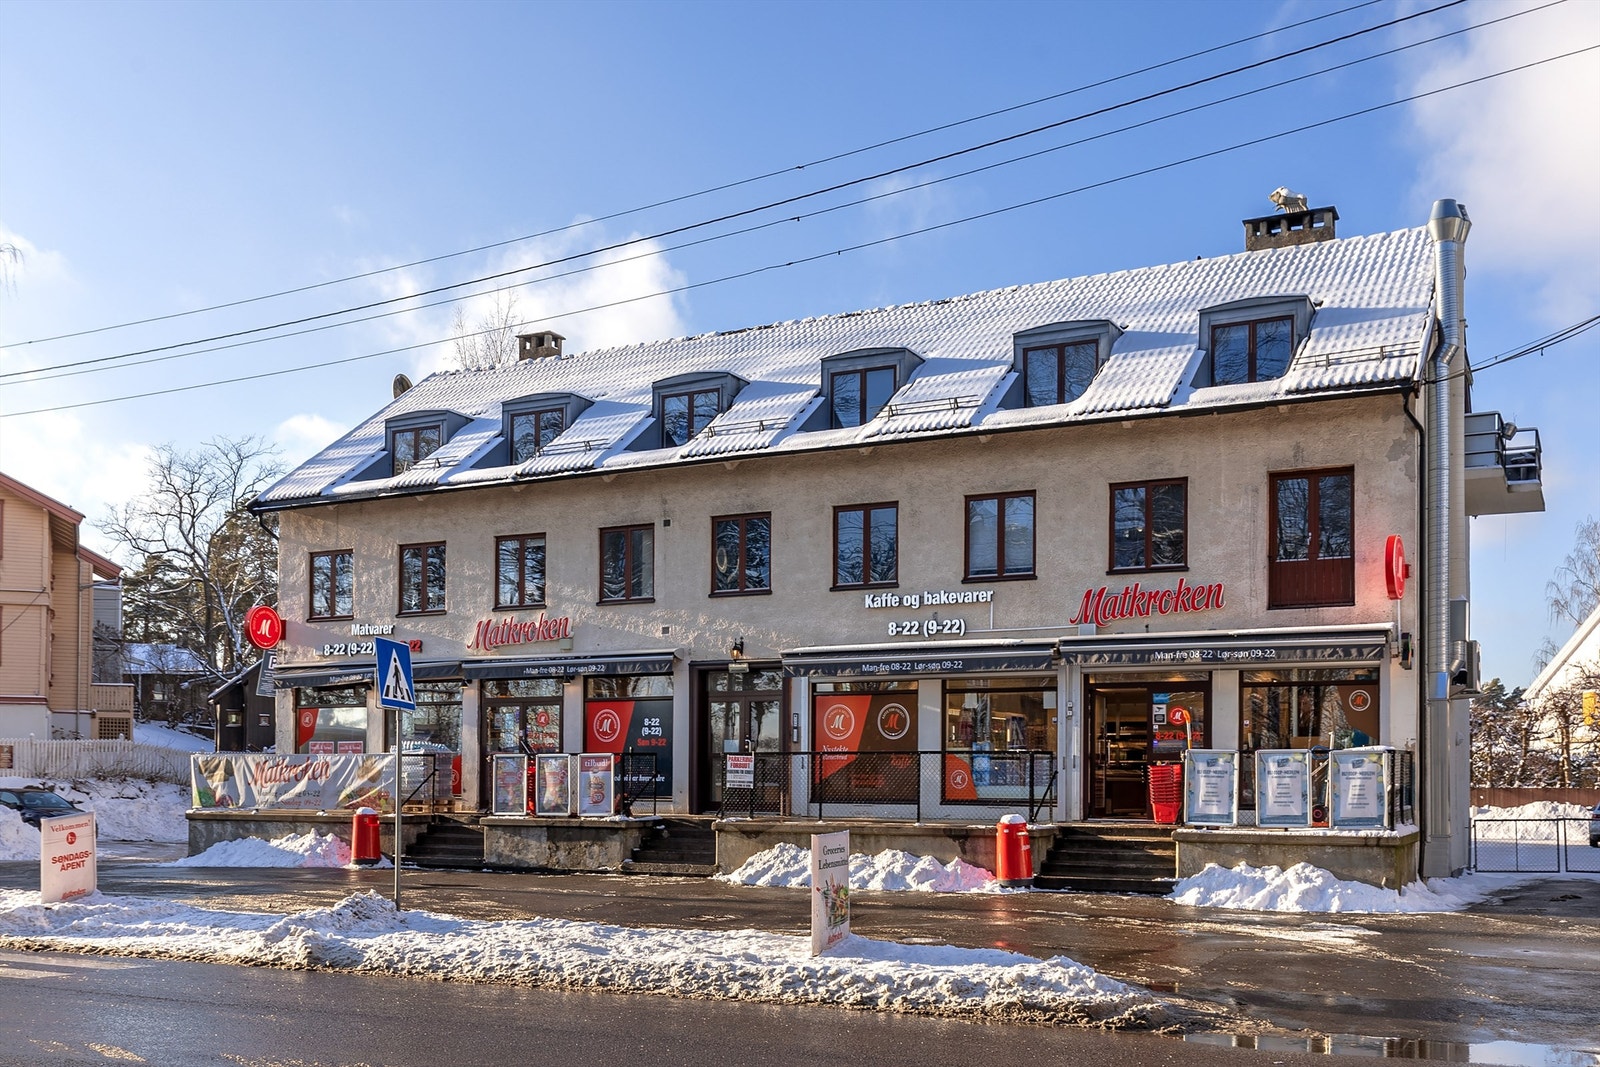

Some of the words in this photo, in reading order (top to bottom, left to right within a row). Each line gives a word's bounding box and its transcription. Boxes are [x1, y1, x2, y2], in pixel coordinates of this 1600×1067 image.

[864, 592, 900, 609] Kaffe
[902, 593, 920, 609] og
[923, 589, 994, 606] bakevarer
[1069, 577, 1225, 628] Matkroken
[351, 623, 394, 637] Matvarer
[467, 612, 571, 652] Matkroken
[887, 620, 920, 636] 8-22
[923, 619, 966, 638] (9-22)
[323, 642, 345, 657] 8-22
[347, 641, 376, 658] (9-22)
[1154, 650, 1188, 660] Man-fre
[1189, 649, 1213, 659] 08-22
[1217, 649, 1250, 659] Lør-søn
[1250, 648, 1276, 658] 09-22
[588, 663, 606, 673] 09-22
[862, 664, 890, 673] Man-fre
[890, 662, 912, 671] 08-22
[914, 662, 941, 671] Lør-søn
[941, 660, 963, 670] 09-22
[644, 717, 660, 727] 8-22
[641, 726, 662, 737] (9-22)
[651, 738, 667, 747] 9-22
[248, 756, 331, 788] Matkroken
[51, 819, 91, 833] Velkommen!
[822, 843, 846, 856] Groceries
[51, 850, 92, 865] SØNDAGS-
